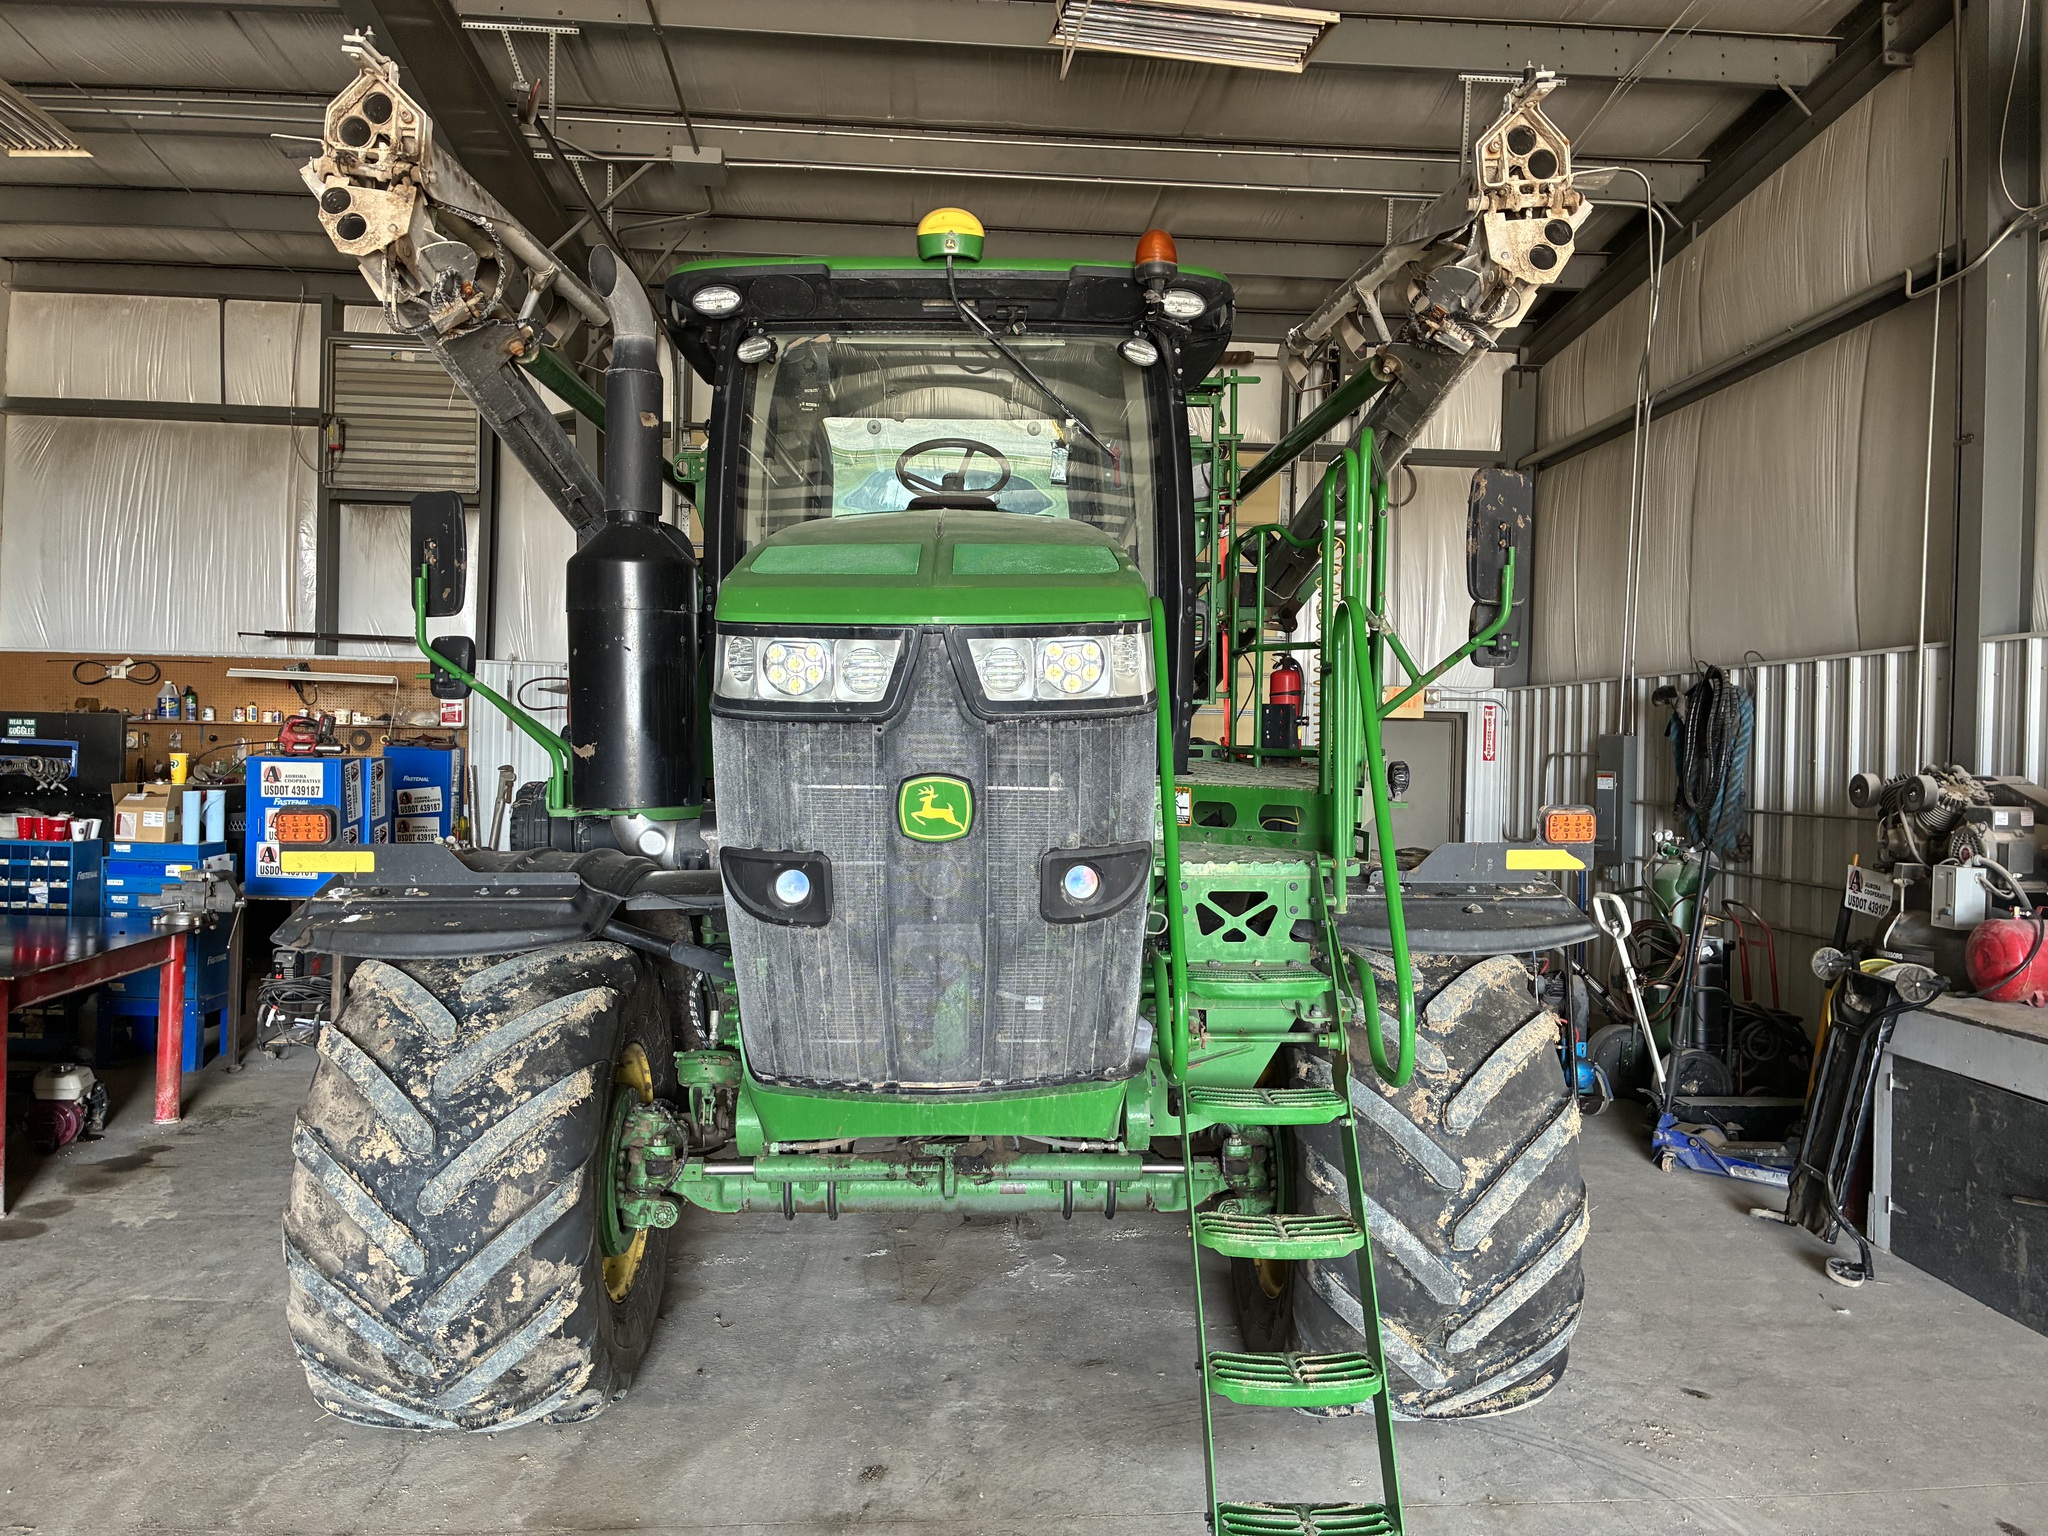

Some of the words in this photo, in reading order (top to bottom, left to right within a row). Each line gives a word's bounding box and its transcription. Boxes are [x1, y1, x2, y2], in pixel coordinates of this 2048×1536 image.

[8, 726, 35, 735] GOGGLES
[264, 785, 289, 795] USDOT
[291, 786, 320, 796] 439187
[273, 798, 310, 806] FASTENAL
[400, 805, 418, 813] USDOT
[419, 803, 441, 812] 439187
[397, 834, 416, 842] USDOT
[260, 865, 283, 875] USDO
[1864, 882, 1881, 891] AURORA
[1864, 889, 1891, 902] COOPERATIVE
[1848, 895, 1867, 910] USDOT
[1868, 900, 1889, 916] 439187
